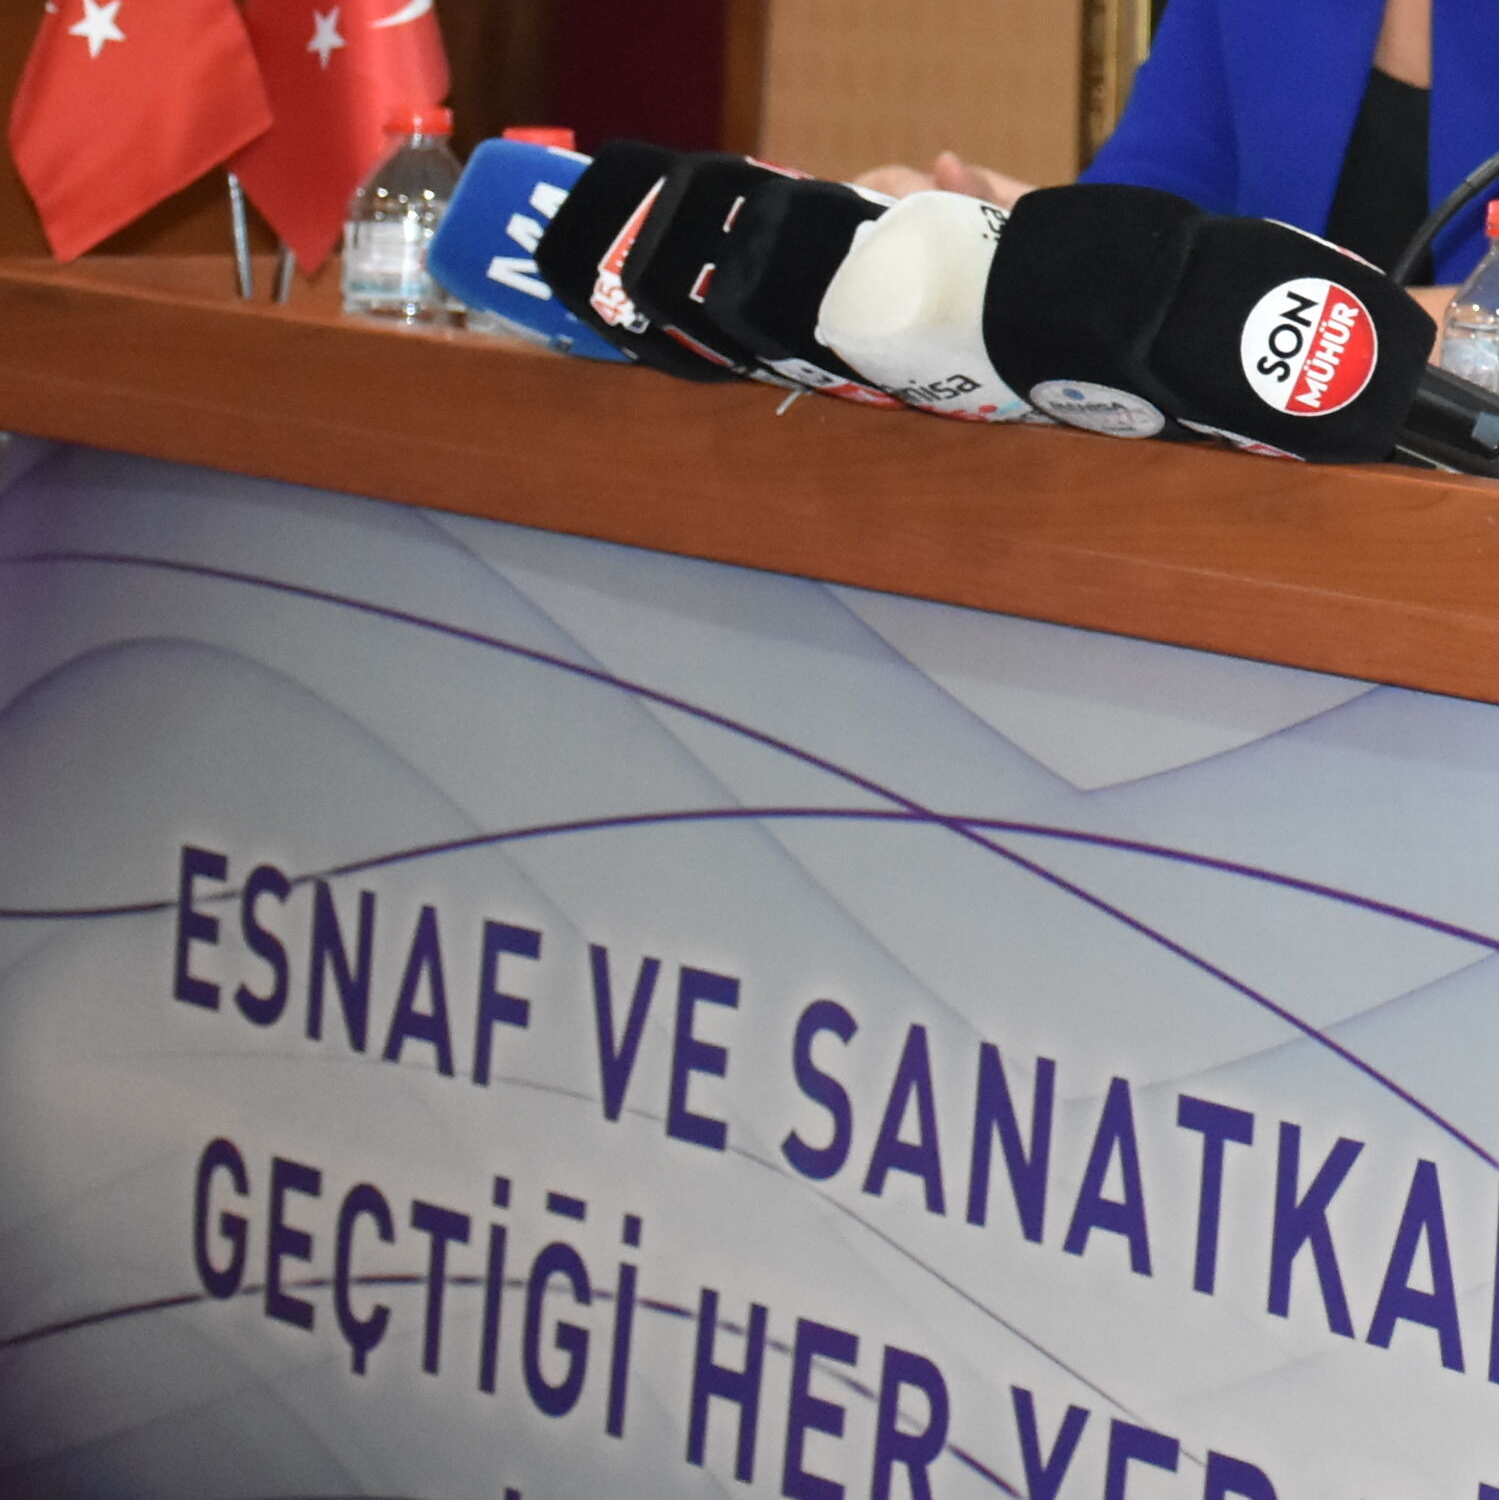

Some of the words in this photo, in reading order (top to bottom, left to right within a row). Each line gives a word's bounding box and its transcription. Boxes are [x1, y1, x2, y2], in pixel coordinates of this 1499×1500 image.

[1256, 290, 1320, 383] SON
[1294, 302, 1360, 408] MÜHÜR
[173, 845, 543, 1087] ESNAF
[588, 943, 742, 1152] VE
[191, 1138, 644, 1439] GEÇTİĞİ
[685, 1286, 950, 1500] HER
